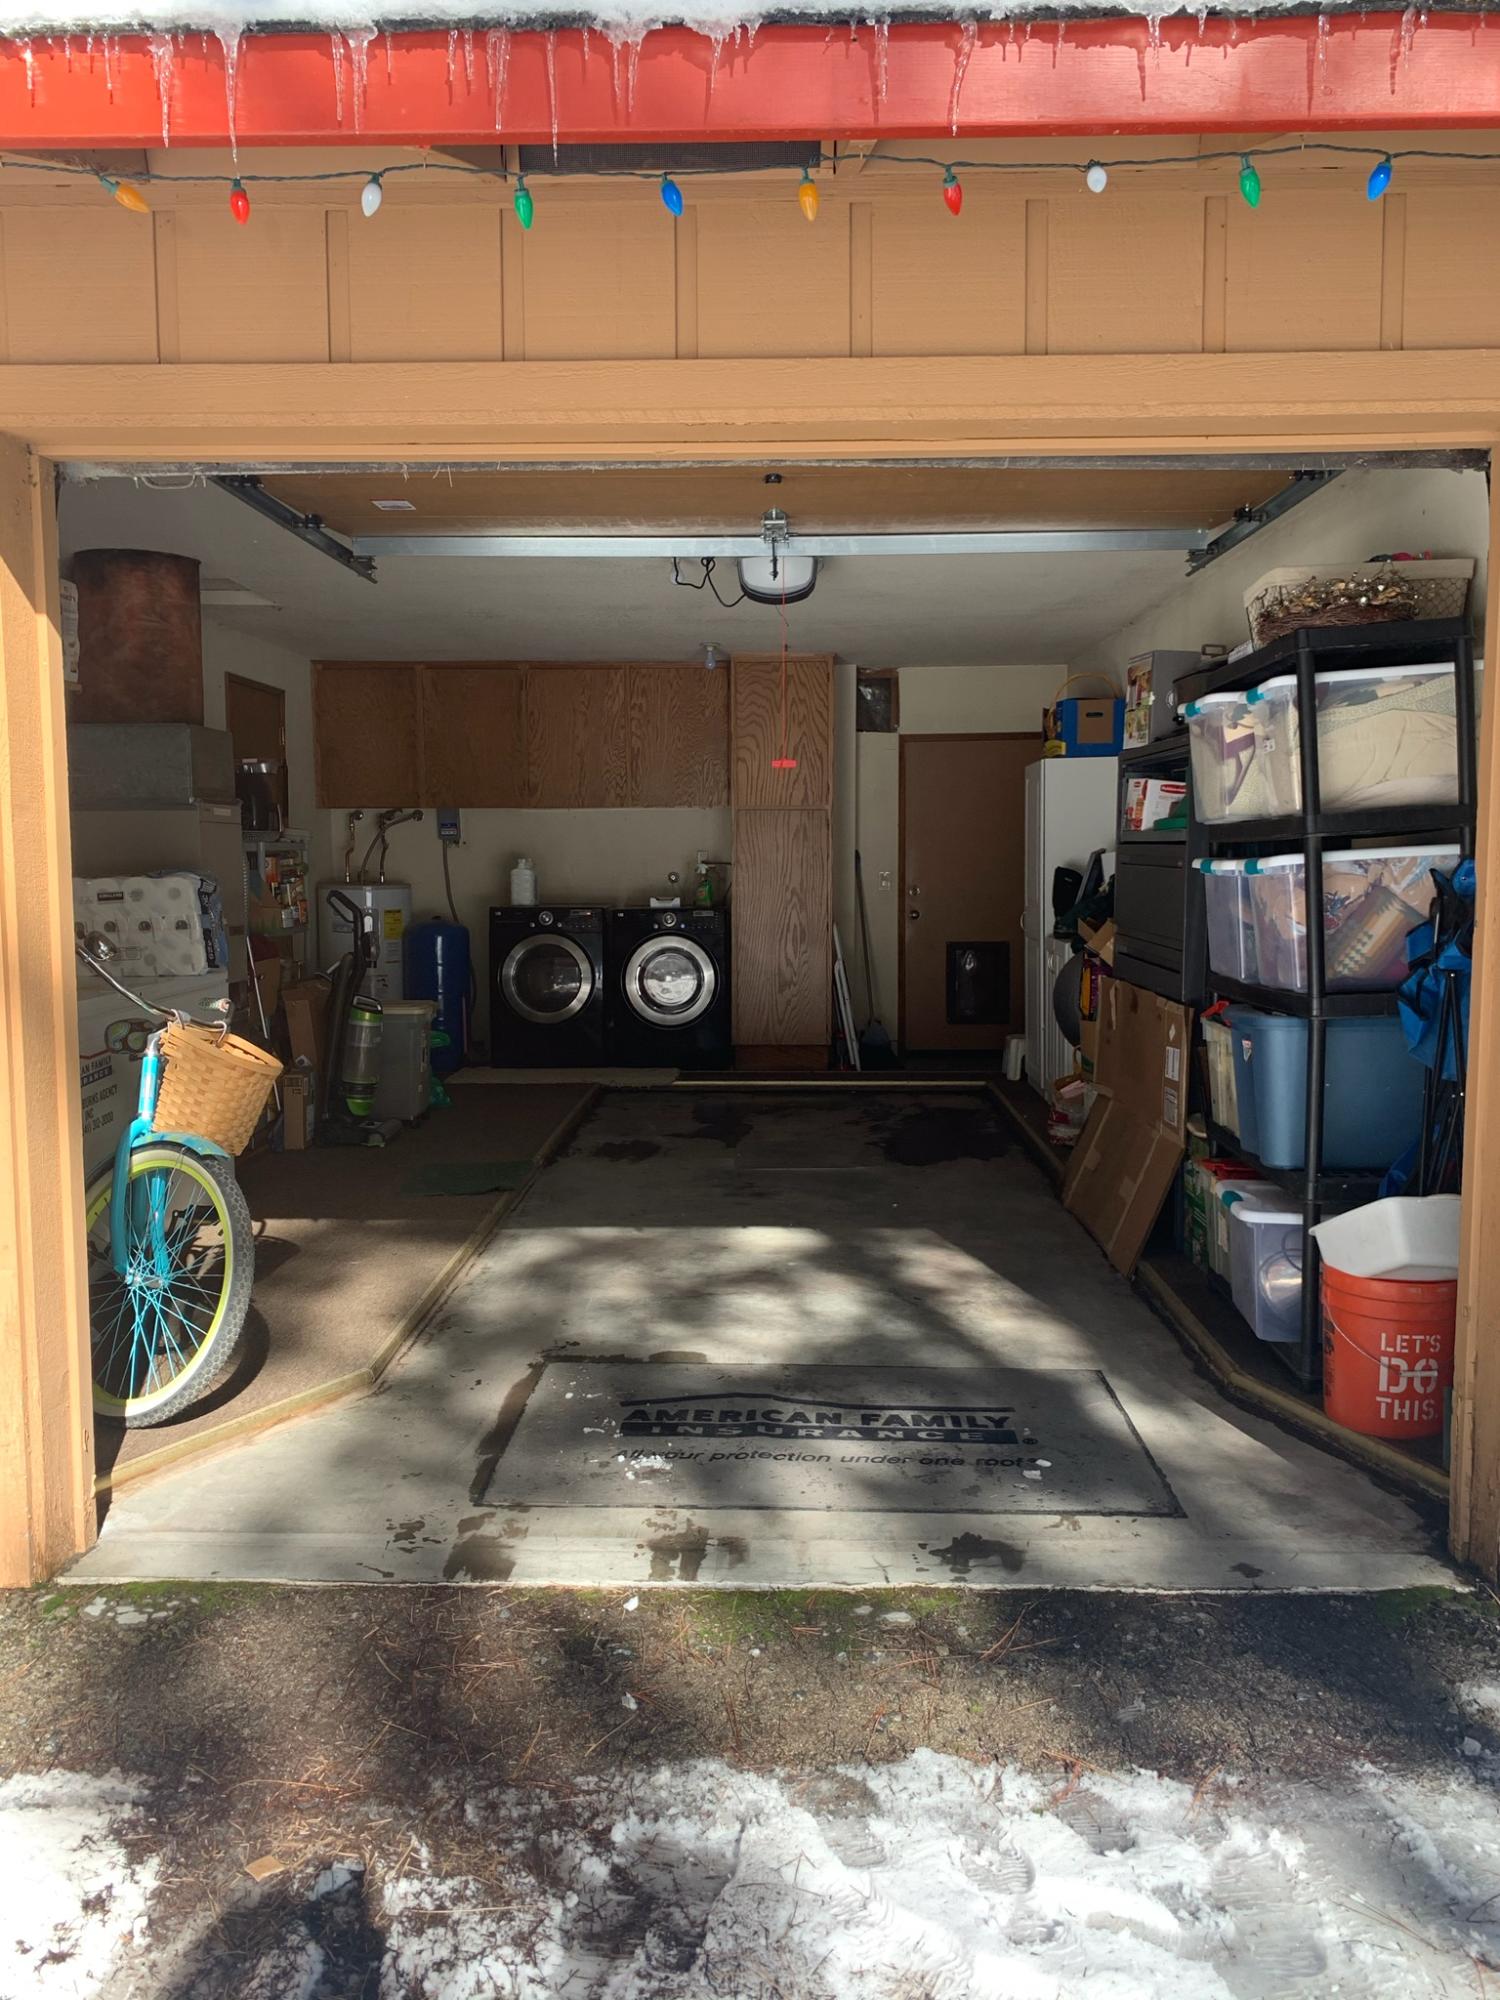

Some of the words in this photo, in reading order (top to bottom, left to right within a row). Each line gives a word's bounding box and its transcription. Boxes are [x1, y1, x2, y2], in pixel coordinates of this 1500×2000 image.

[1380, 1332, 1441, 1353] LET'S
[1379, 1356, 1439, 1394] DO
[623, 1408, 842, 1425] AMERICAN
[861, 1413, 1011, 1429] FAMILY
[650, 1426, 985, 1440] INSURANCE
[709, 1450, 830, 1463] protection
[839, 1453, 912, 1465] under
[919, 1456, 965, 1466] one
